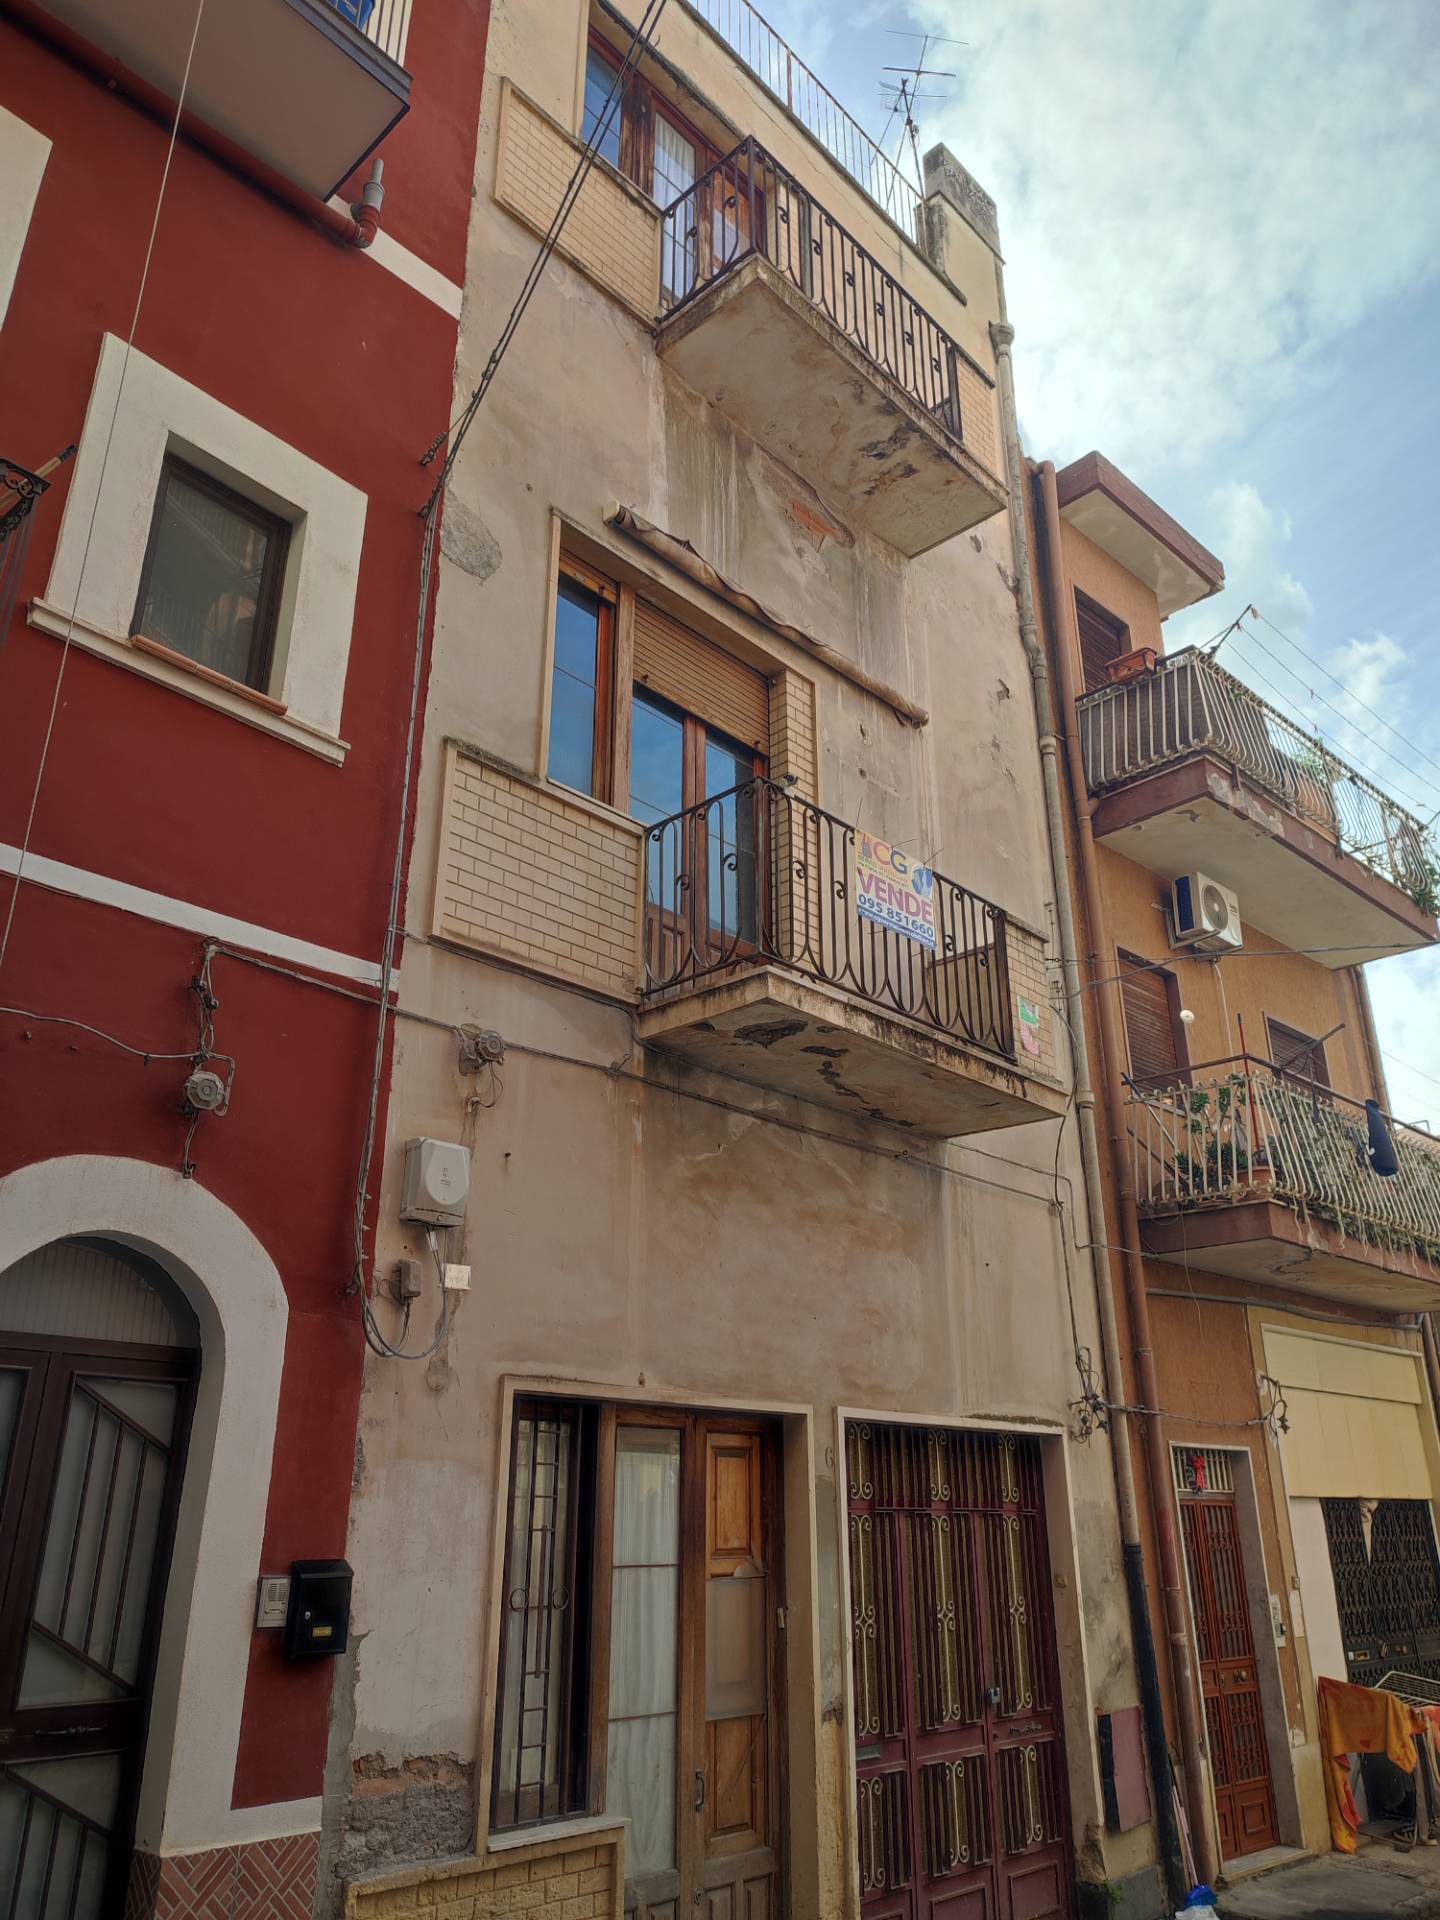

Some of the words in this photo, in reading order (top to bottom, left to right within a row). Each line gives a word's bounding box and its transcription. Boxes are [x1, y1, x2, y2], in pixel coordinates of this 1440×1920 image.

[857, 866, 934, 926] VENDE
[858, 894, 883, 914] 095
[886, 907, 934, 938] 851660
